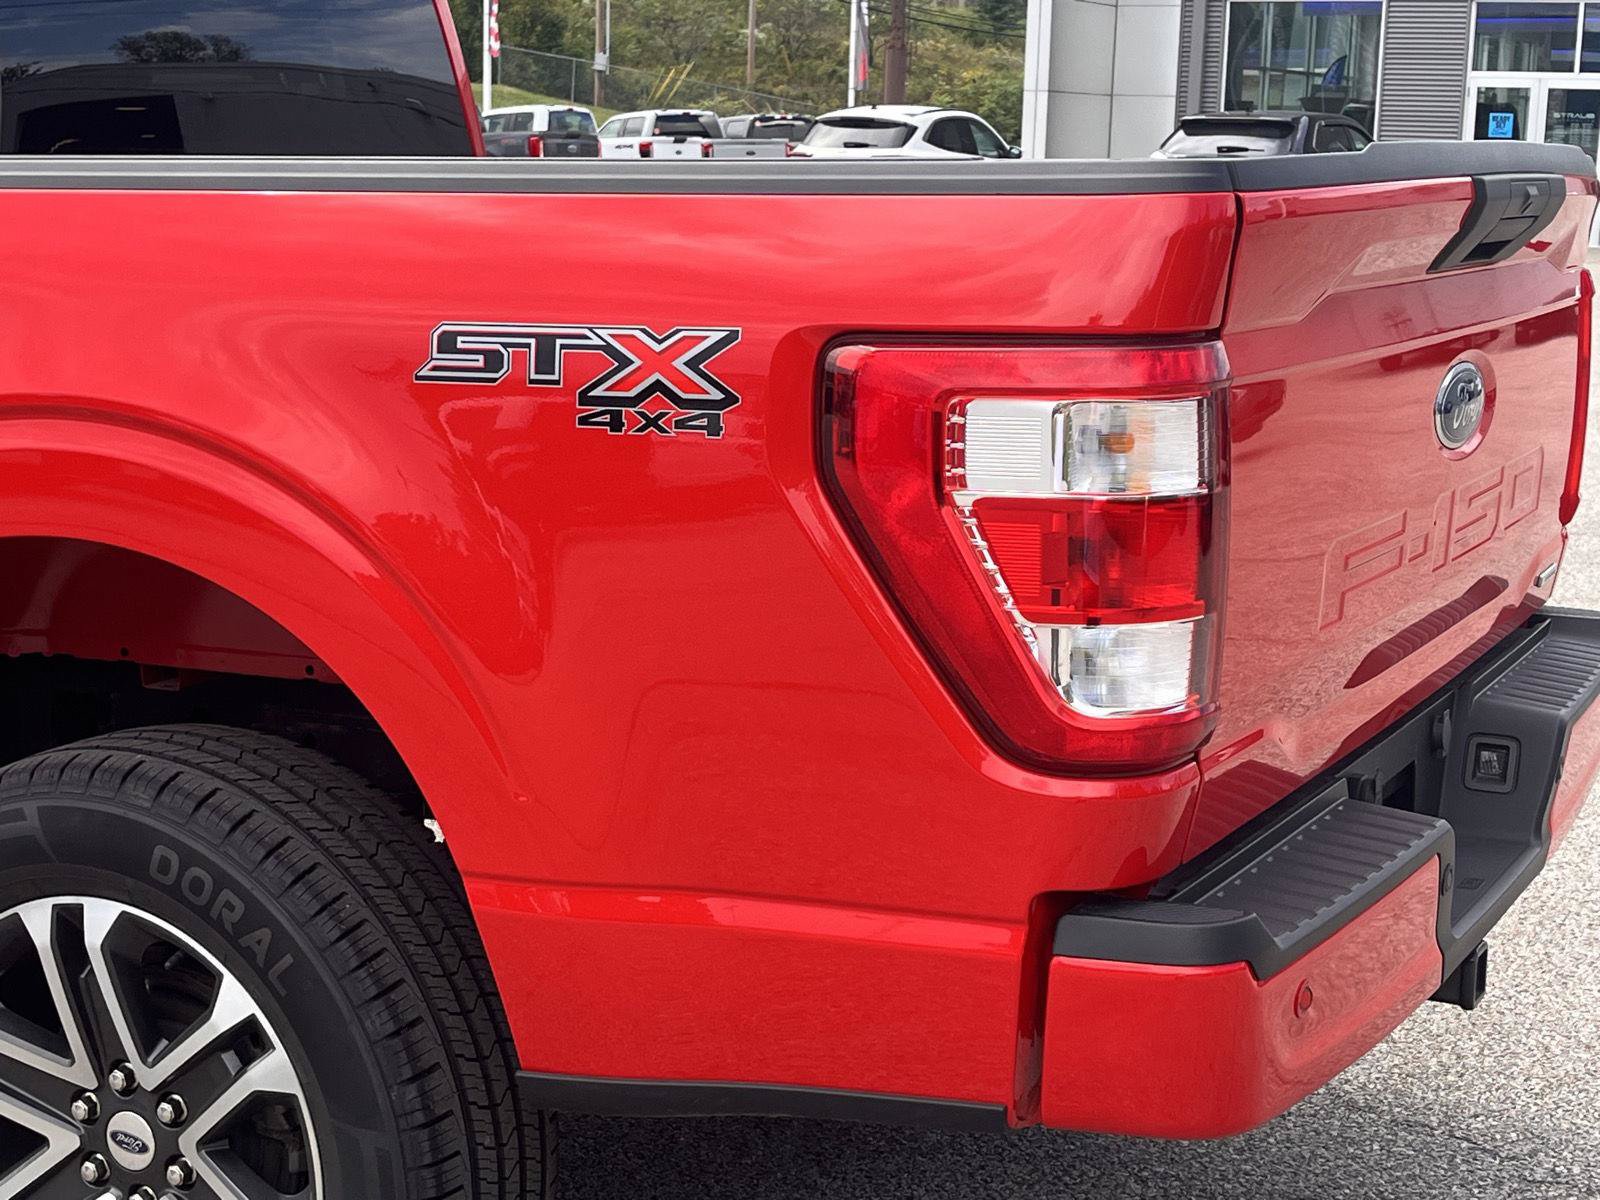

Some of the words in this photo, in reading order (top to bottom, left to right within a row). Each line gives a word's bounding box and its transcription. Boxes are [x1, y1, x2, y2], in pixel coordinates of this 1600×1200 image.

[413, 321, 742, 412] STX
[576, 408, 725, 439] 4x4
[1318, 445, 1544, 631] F-150
[150, 844, 295, 997] DORAL
[115, 1132, 143, 1152] Ford
